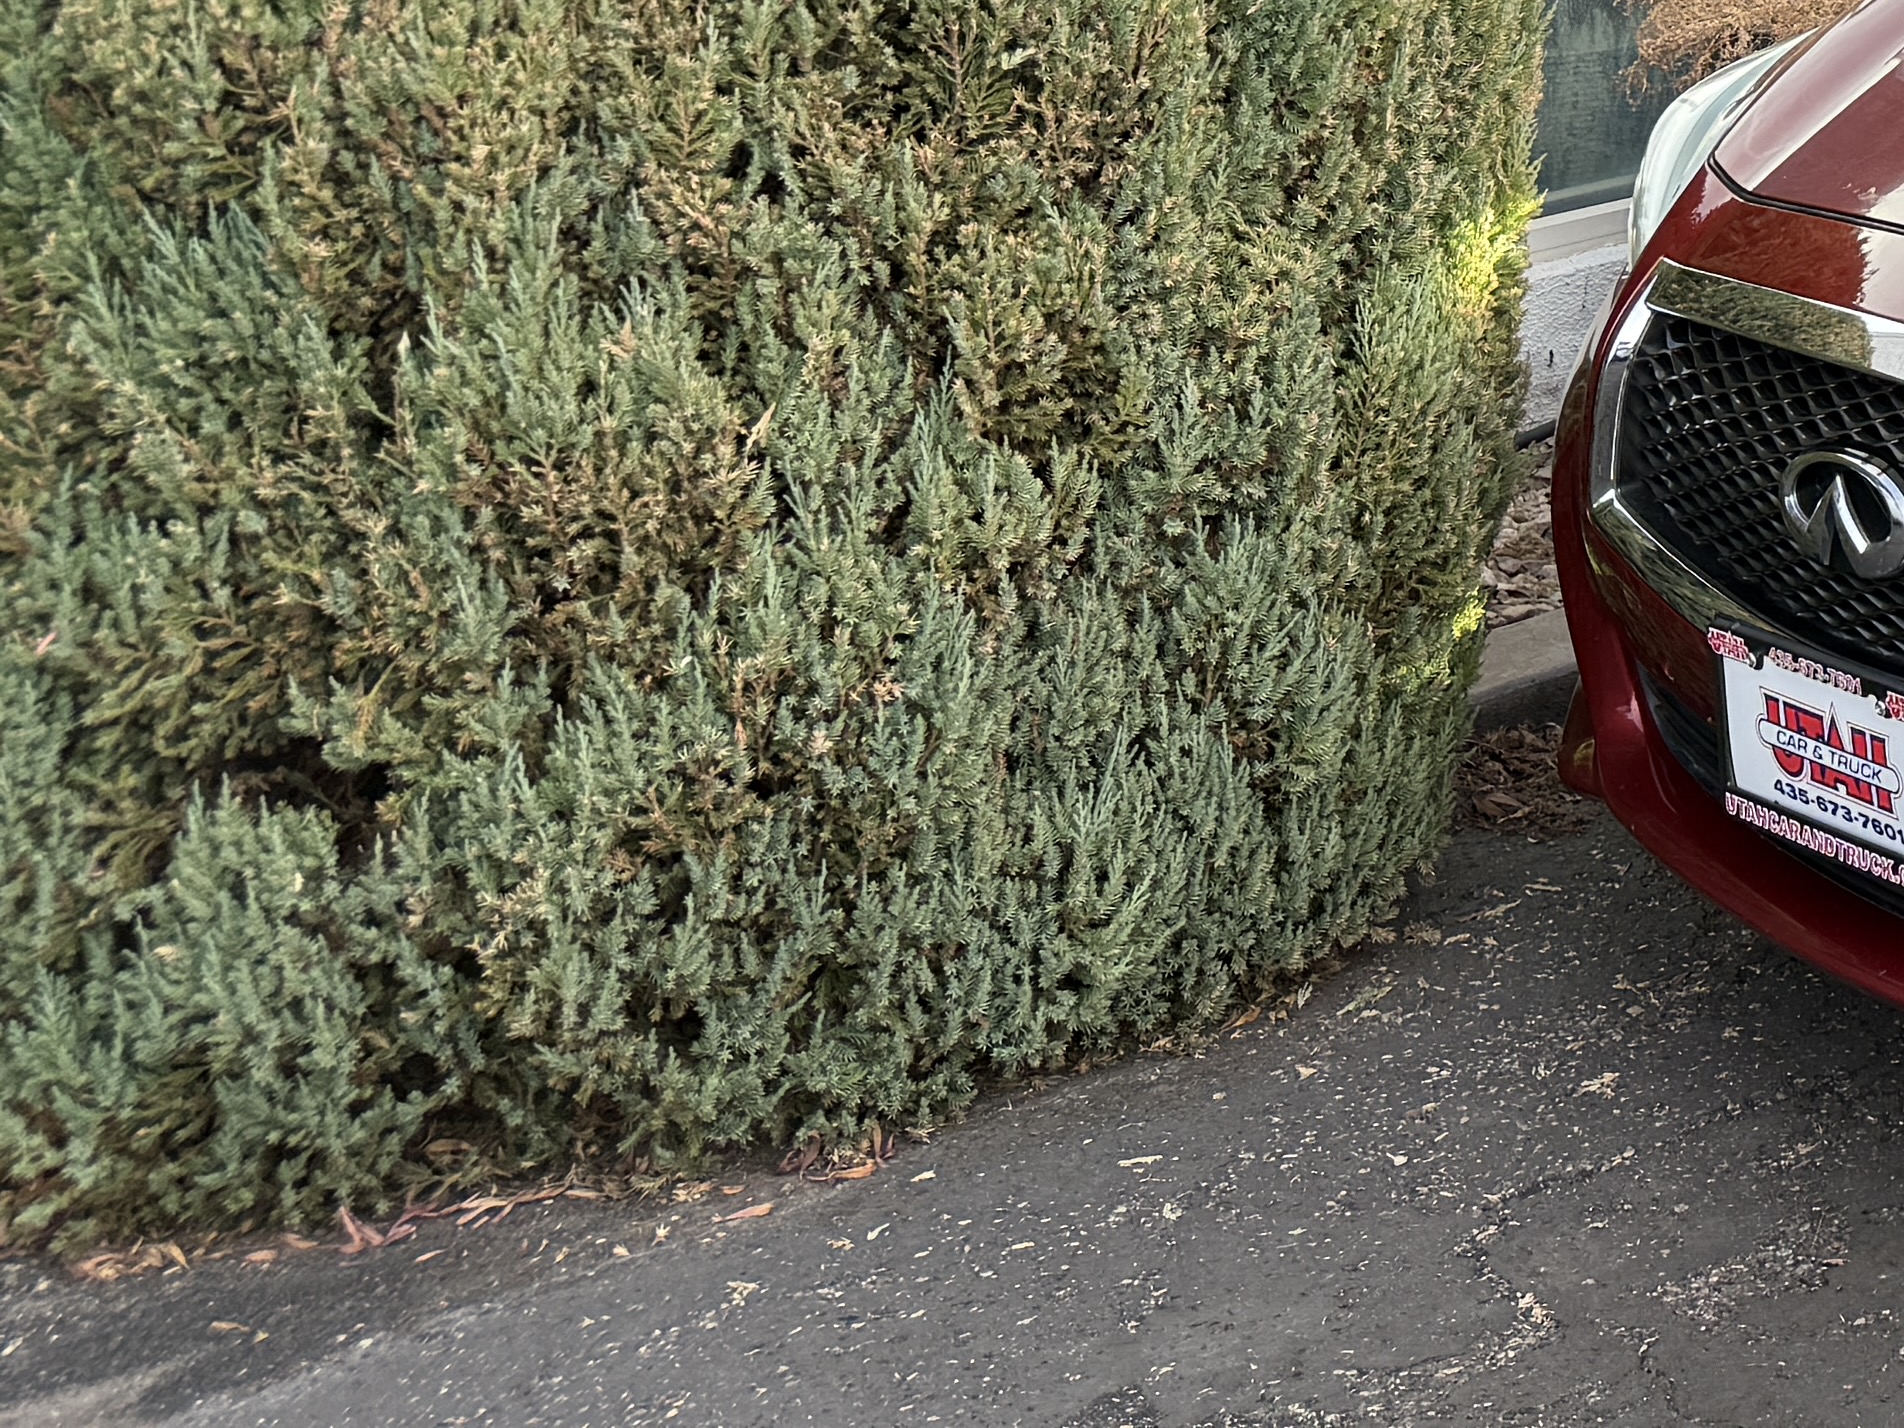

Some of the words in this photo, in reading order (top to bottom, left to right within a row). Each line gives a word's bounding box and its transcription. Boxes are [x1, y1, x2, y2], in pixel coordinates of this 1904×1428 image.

[1763, 692, 1895, 815] UTAH
[1776, 730, 1808, 754] CAR
[1828, 749, 1883, 784] TRUCK
